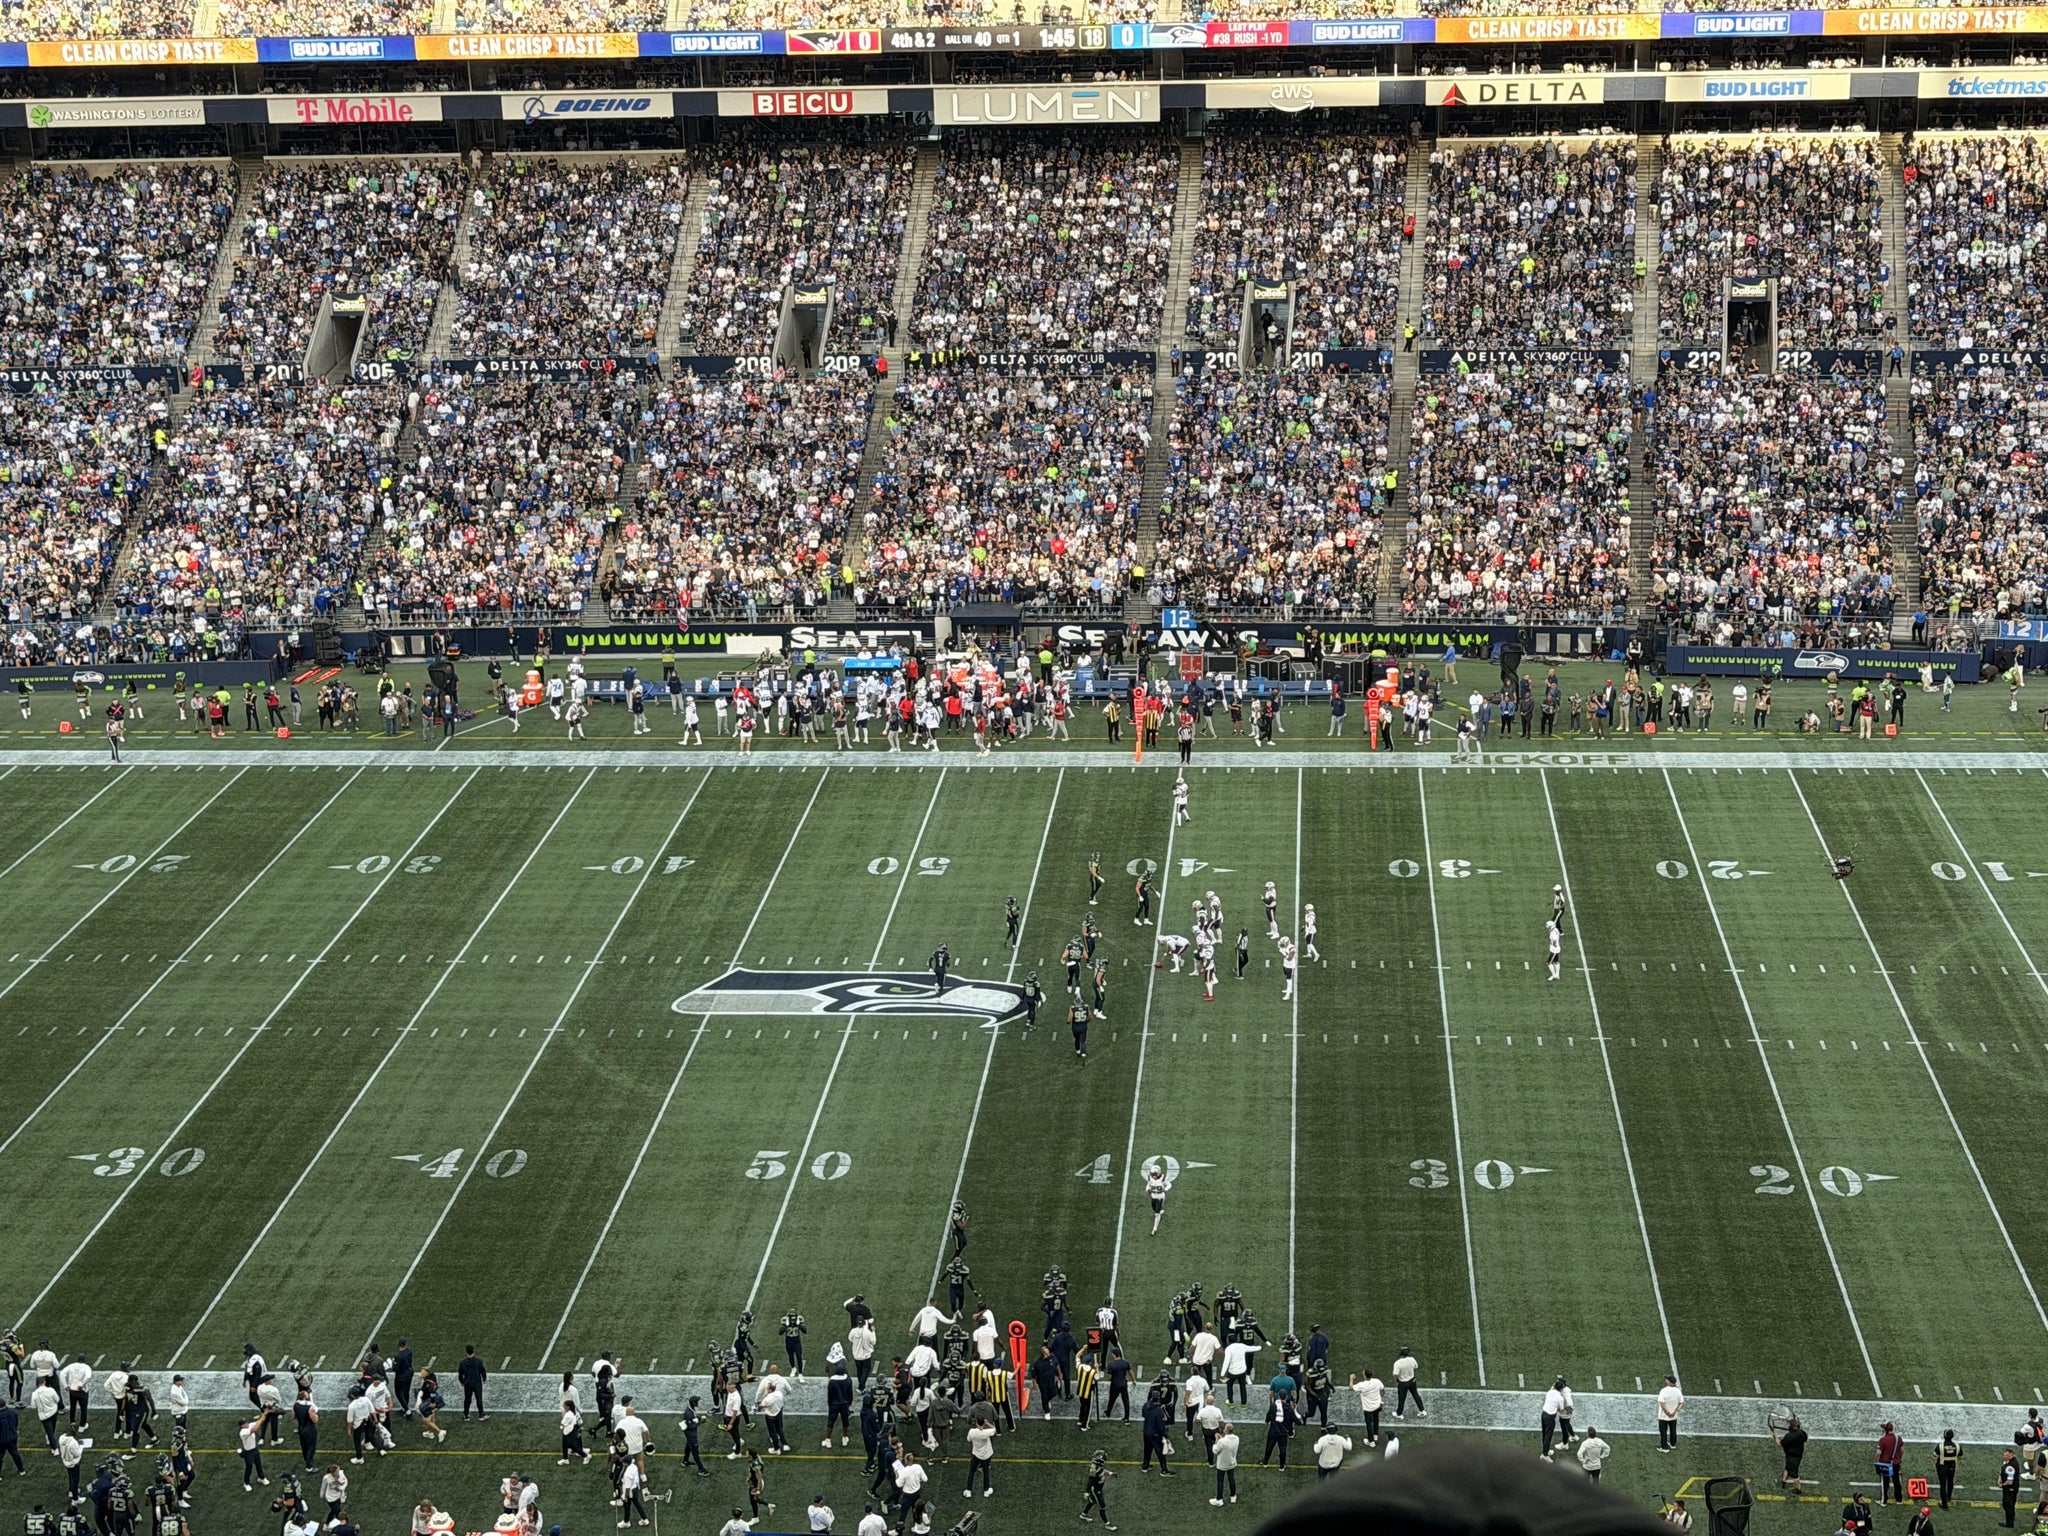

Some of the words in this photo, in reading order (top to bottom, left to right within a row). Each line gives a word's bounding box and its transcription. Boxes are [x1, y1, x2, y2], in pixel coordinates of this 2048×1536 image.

[1228, 23, 1248, 31] LAST
[1249, 23, 1267, 31] PLAY
[1469, 21, 1522, 39] CLEAN
[1526, 19, 1573, 37] CRISP
[1577, 18, 1626, 36] TASTE
[1697, 18, 1734, 32] BUD
[1735, 17, 1787, 31] LIGHT
[1858, 13, 1914, 31] CLEAN
[1918, 12, 1969, 30] CRISP
[1973, 10, 2027, 29] TASTE
[891, 32, 913, 48] 4th
[914, 32, 925, 48] &
[926, 33, 936, 47] 2
[945, 35, 962, 45] BALL
[974, 32, 992, 47] 40
[996, 34, 1010, 44] QTR
[1012, 31, 1020, 46] 1
[1040, 28, 1076, 47] 1:45
[1084, 29, 1102, 46] 18
[1121, 27, 1134, 46] 0
[1213, 33, 1230, 44] #38
[1234, 32, 1257, 44] RUSH
[1270, 32, 1283, 43] YD
[1315, 26, 1352, 40] BUD
[1352, 25, 1401, 39] LIGHT
[294, 43, 330, 56] BUD
[331, 41, 381, 56] LIGHT
[448, 38, 500, 56] CLEAN
[505, 37, 551, 55] CRISP
[555, 36, 605, 54] TASTE
[674, 37, 710, 51] BUD
[710, 36, 760, 50] LIGHT
[858, 32, 871, 50] 0
[61, 43, 117, 62] CLEAN
[120, 42, 166, 61] CRISP
[169, 41, 224, 60] TASTE
[1271, 82, 1314, 100] aws
[1479, 82, 1587, 102] DELTA
[1706, 82, 1748, 97] BUD
[1749, 81, 1808, 96] LIGHT
[296, 98, 319, 123] T
[324, 97, 414, 124] Mobile
[554, 98, 651, 112] BOEING
[757, 94, 848, 114] BECU
[952, 90, 1142, 122] LUMEN
[53, 107, 146, 120] WASHINGTON'S
[150, 107, 201, 119] LOTTERY
[1255, 289, 1287, 297] DaBella
[1732, 287, 1766, 295] DaBella
[978, 355, 1028, 366] DELTA
[1077, 354, 1105, 364] CLUB
[1205, 352, 1238, 370] 210
[1291, 352, 1324, 369] 210
[1467, 351, 1518, 362] DELTA
[1570, 350, 1595, 361] CLU
[1778, 351, 1813, 369] 212
[489, 361, 539, 372] DELTA
[735, 356, 772, 374] 208
[1169, 609, 1190, 628] 12
[2006, 620, 2032, 638] 12
[1074, 1011, 1087, 1022] 95
[1088, 1330, 1100, 1344] 3
[1911, 1482, 1927, 1496] 20
[26, 1519, 45, 1535] 55
[161, 1521, 179, 1536] 88
